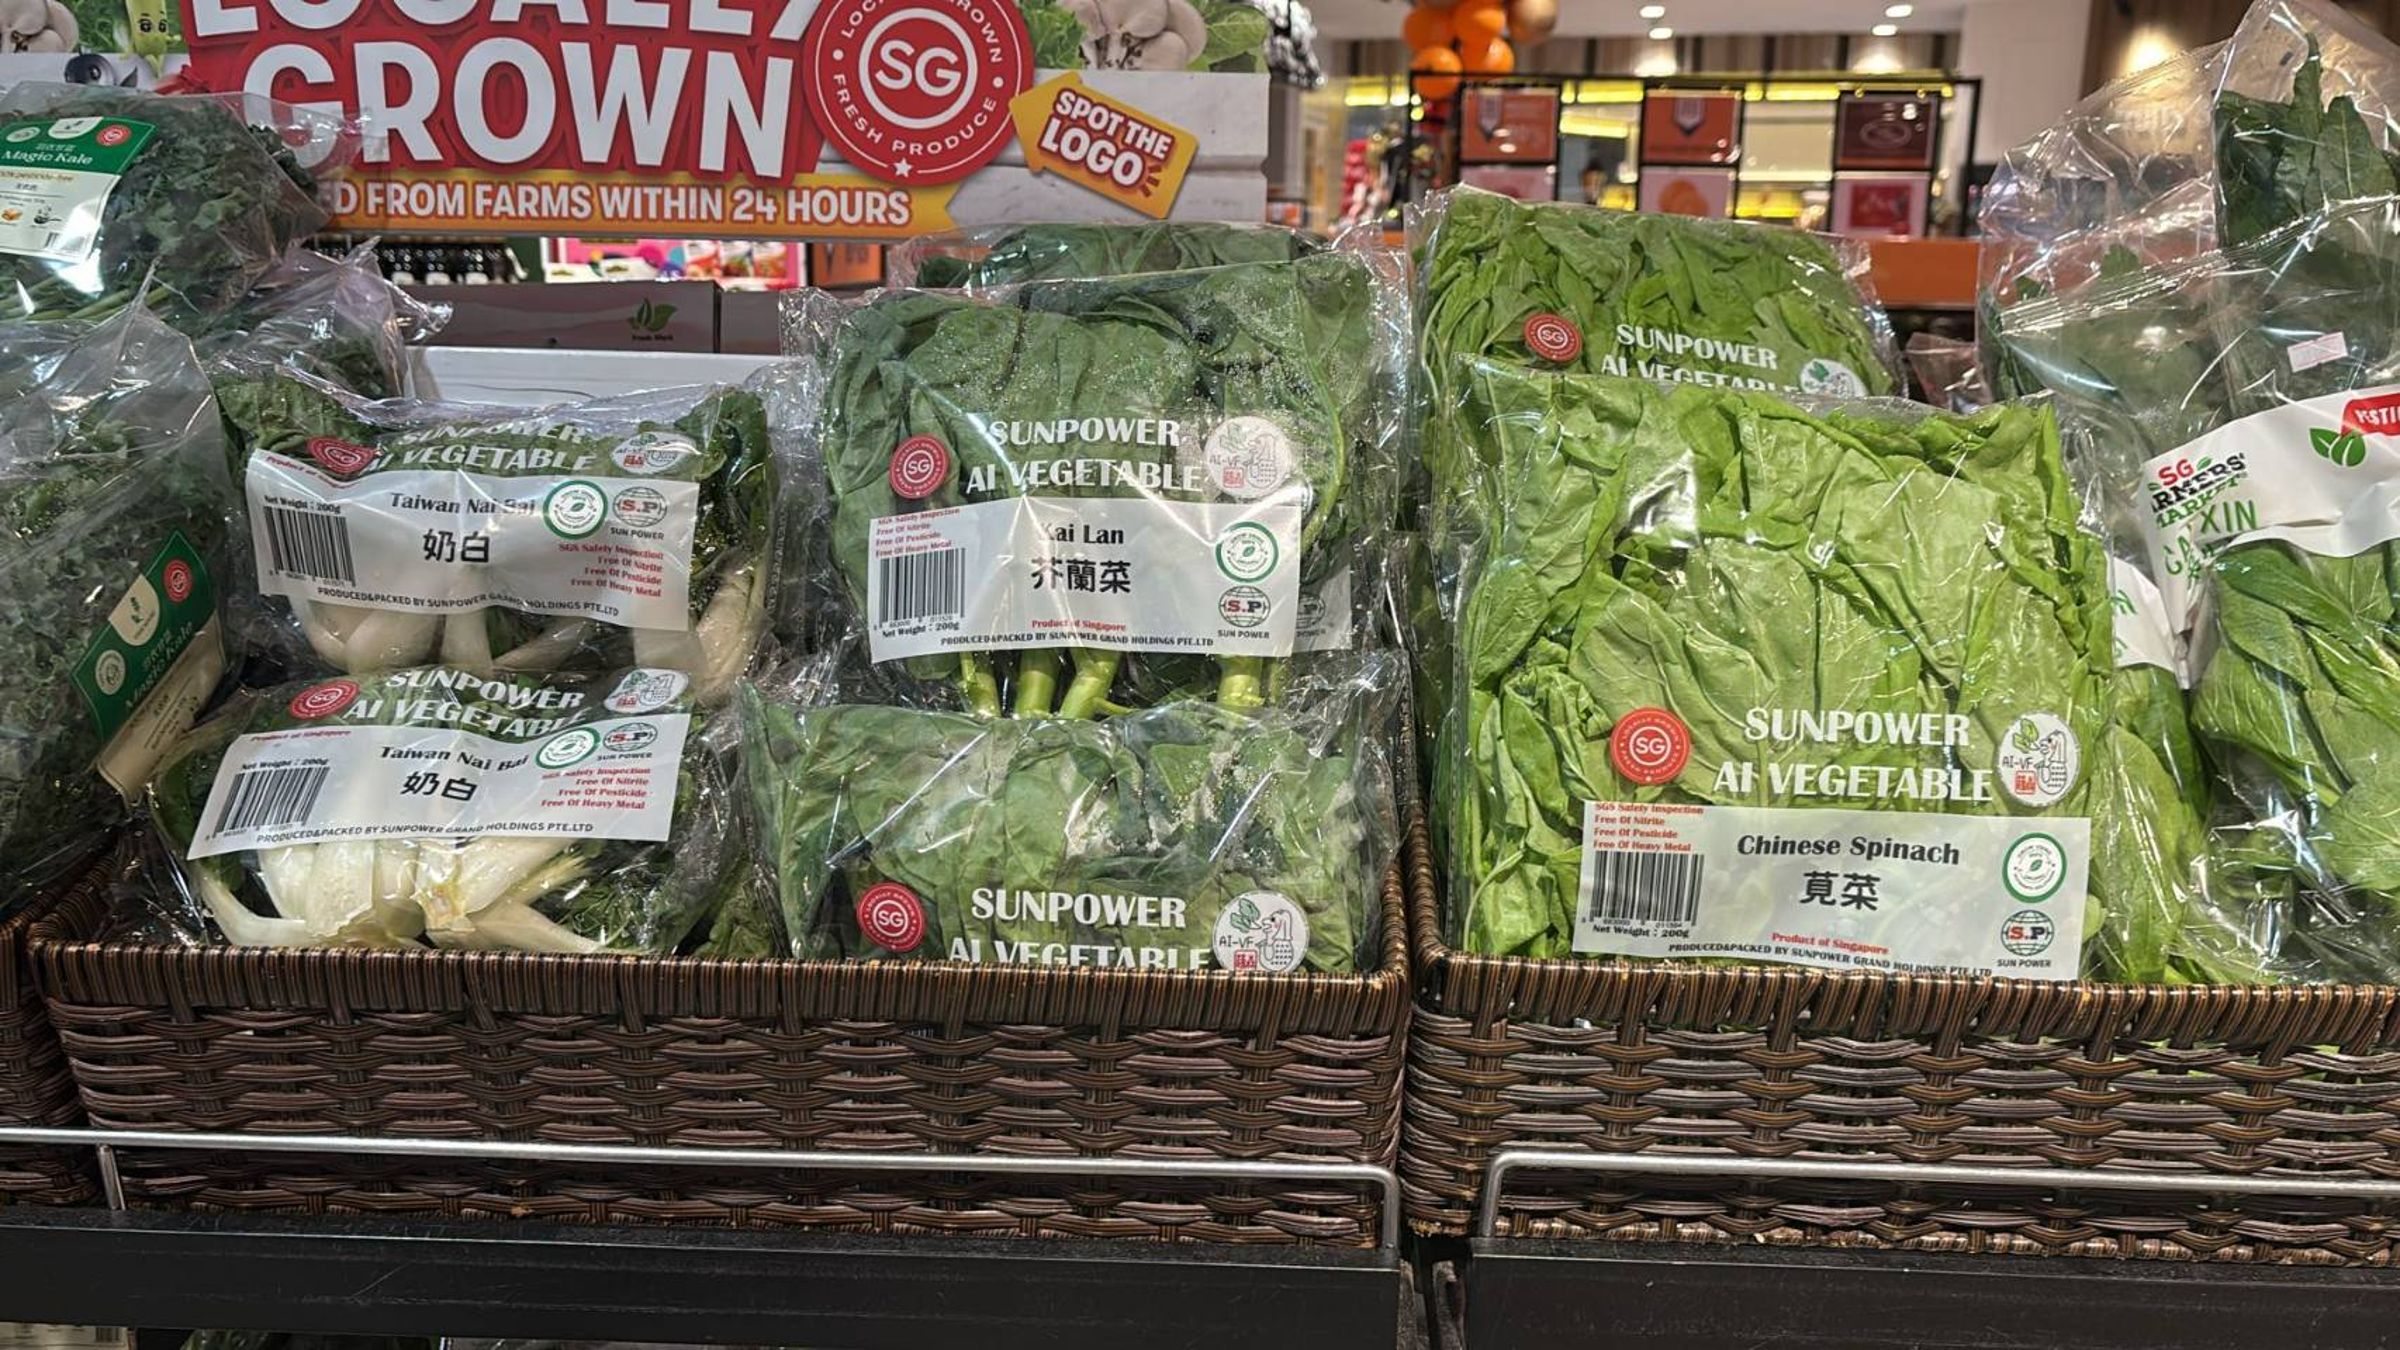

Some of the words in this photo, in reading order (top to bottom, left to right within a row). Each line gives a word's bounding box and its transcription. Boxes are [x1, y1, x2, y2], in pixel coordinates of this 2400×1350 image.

[875, 39, 961, 97] SG
[242, 37, 794, 179] GROWN
[833, 74, 883, 144] FRESH
[892, 98, 997, 155] PRODUCE
[1055, 90, 1124, 137] SPOT
[1123, 119, 1173, 159] THE
[1040, 117, 1144, 186] LOGO
[366, 181, 466, 217] FROM
[474, 184, 593, 220] FARMS
[599, 186, 723, 220] WITHIN
[732, 189, 777, 222] 24
[787, 189, 912, 226] HOURS
[1616, 324, 1779, 371] SUNPOWER
[1601, 354, 1628, 378] AI
[989, 417, 1181, 446] SUNPOWER
[403, 445, 598, 472] VEGETABLE
[908, 459, 930, 475] SG
[966, 463, 997, 494] AI
[1009, 458, 1204, 492] VEGETABLE
[2158, 459, 2195, 486] SG
[391, 492, 460, 514] Taiwan
[466, 498, 497, 514] Nai
[2200, 500, 2258, 534] XIN
[422, 528, 490, 563] 奶白
[610, 527, 628, 536] SUN
[630, 529, 665, 540] POWER
[1083, 524, 1124, 545] Lan
[1030, 556, 1132, 594] 芥蘭菜
[413, 598, 425, 606] BY
[427, 594, 486, 608] SUNPOWER
[1227, 599, 1262, 612] S.P
[1036, 632, 1048, 642] BY
[1082, 620, 1126, 633] Singapore
[1217, 629, 1236, 638] SUN
[1238, 630, 1270, 639] POWER
[385, 669, 585, 710] SUNPOWER
[343, 699, 384, 719] AI
[394, 699, 592, 737] VEGETABLE
[1744, 707, 1970, 747] SUNPOWER
[1635, 736, 1666, 755] SG
[380, 746, 451, 760] Taiwan
[457, 751, 491, 771] Nai
[496, 755, 530, 772] Bai
[2002, 755, 2034, 769] AI-VF
[401, 771, 478, 801] 奶白
[1714, 761, 1757, 793] AI
[1768, 762, 1993, 801] VEGETABLE
[1595, 803, 1616, 812] SGS
[1618, 804, 1649, 814] Safety
[1651, 804, 1704, 815] Inspection
[1595, 815, 1617, 824] Free
[1619, 815, 1632, 824] Of
[1634, 816, 1665, 826] Nitrite
[365, 825, 379, 834] BY
[381, 824, 443, 834] SUNPOWER
[486, 822, 545, 832] HOLDINGS
[547, 822, 593, 832] PTE.LTD
[1594, 828, 1616, 837] Free
[1618, 828, 1630, 837] Of
[1633, 829, 1679, 839] Pesticide
[1593, 841, 1616, 850] Free
[1618, 841, 1630, 850] Of
[1632, 841, 1660, 852] Heavy
[1663, 842, 1691, 851] Metal
[1737, 834, 1841, 856] Chinese
[1850, 836, 1959, 865] Spinach
[1799, 870, 1881, 911] 莧菜
[879, 909, 904, 927] SG
[971, 887, 1187, 929] SUNPOWER
[1219, 936, 1254, 949] AI-VF
[1593, 925, 1610, 933] Net
[1614, 925, 1650, 937] Weight
[1661, 929, 1689, 938] 200g
[1771, 932, 1816, 946] Product
[1818, 936, 1829, 947] of
[1831, 938, 1889, 955] Singapore
[2009, 926, 2045, 940] S.P
[949, 937, 981, 963] AI
[994, 939, 1211, 970] VEGETABLE
[1669, 943, 1770, 955] PRODUCED&PACKED
[1774, 946, 1788, 955] BY
[1791, 947, 1850, 963] SUNPOWER
[1853, 955, 1889, 968] GRAND
[1893, 961, 1947, 974] HOLDINGS
[1949, 965, 1993, 977] PTELTD
[1997, 959, 2016, 967] SUN
[2018, 959, 2051, 968] POWER
